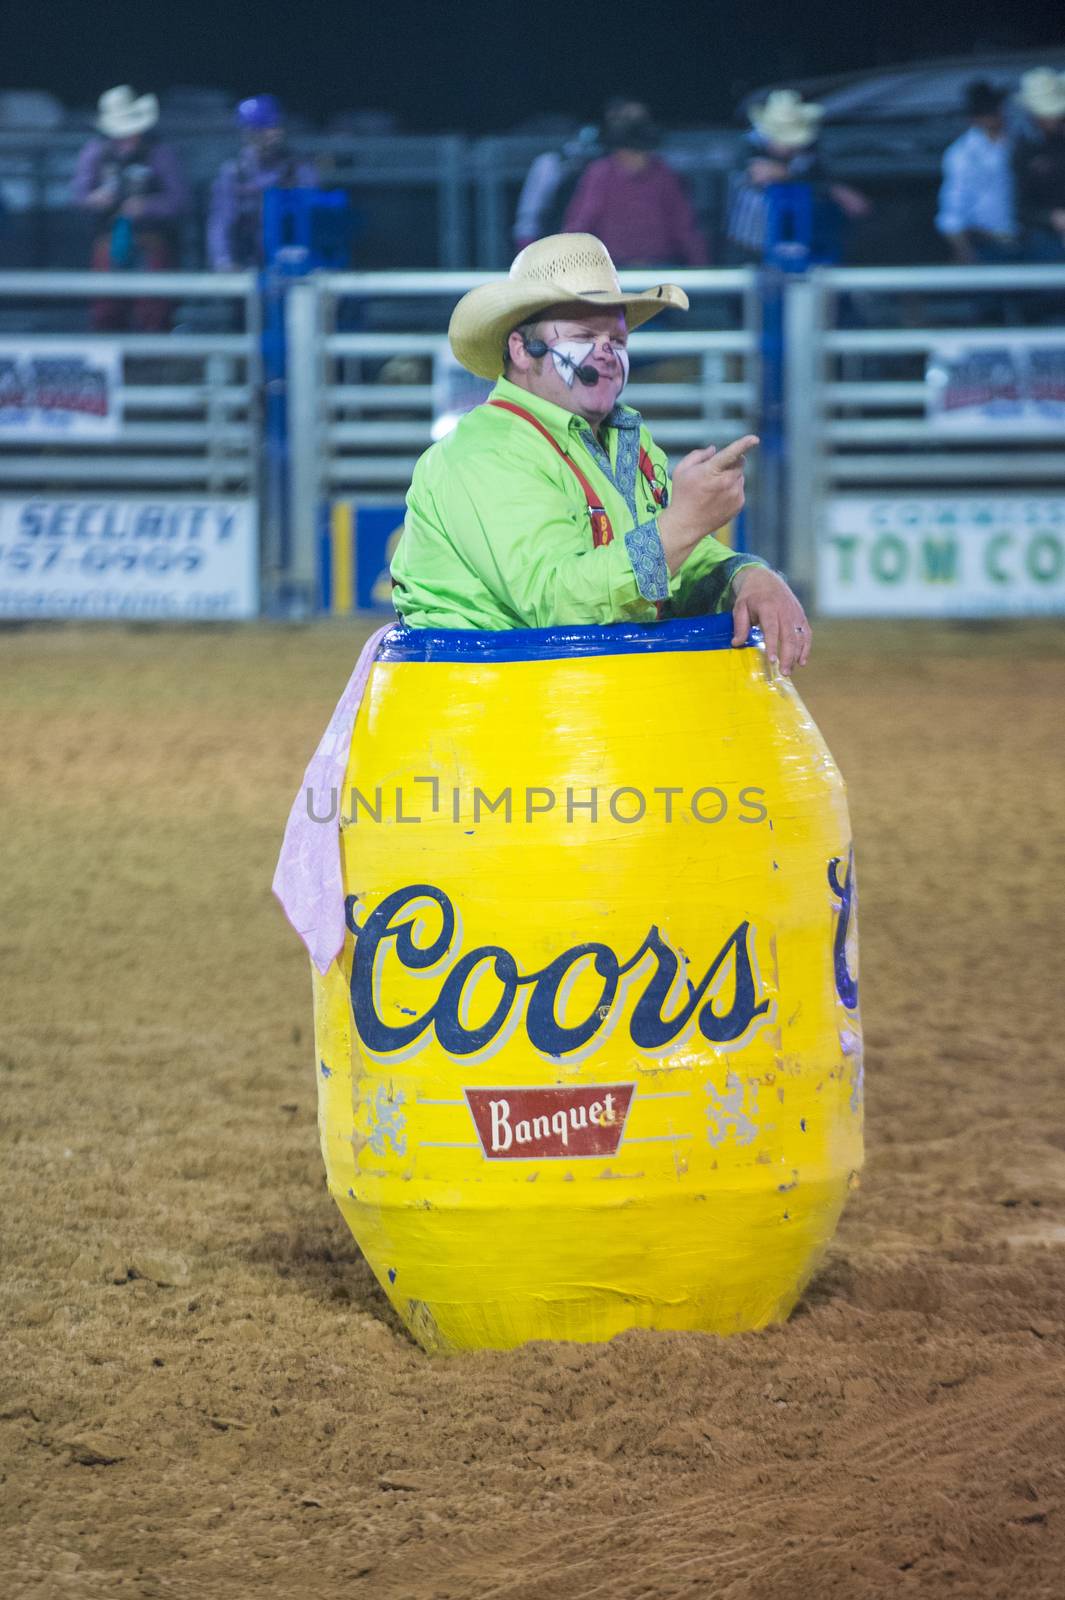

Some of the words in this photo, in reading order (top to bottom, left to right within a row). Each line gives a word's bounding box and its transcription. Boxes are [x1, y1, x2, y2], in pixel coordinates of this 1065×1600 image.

[19, 502, 239, 540] SECURITY
[344, 883, 771, 1058] Coors
[488, 1092, 617, 1152] Banquet
